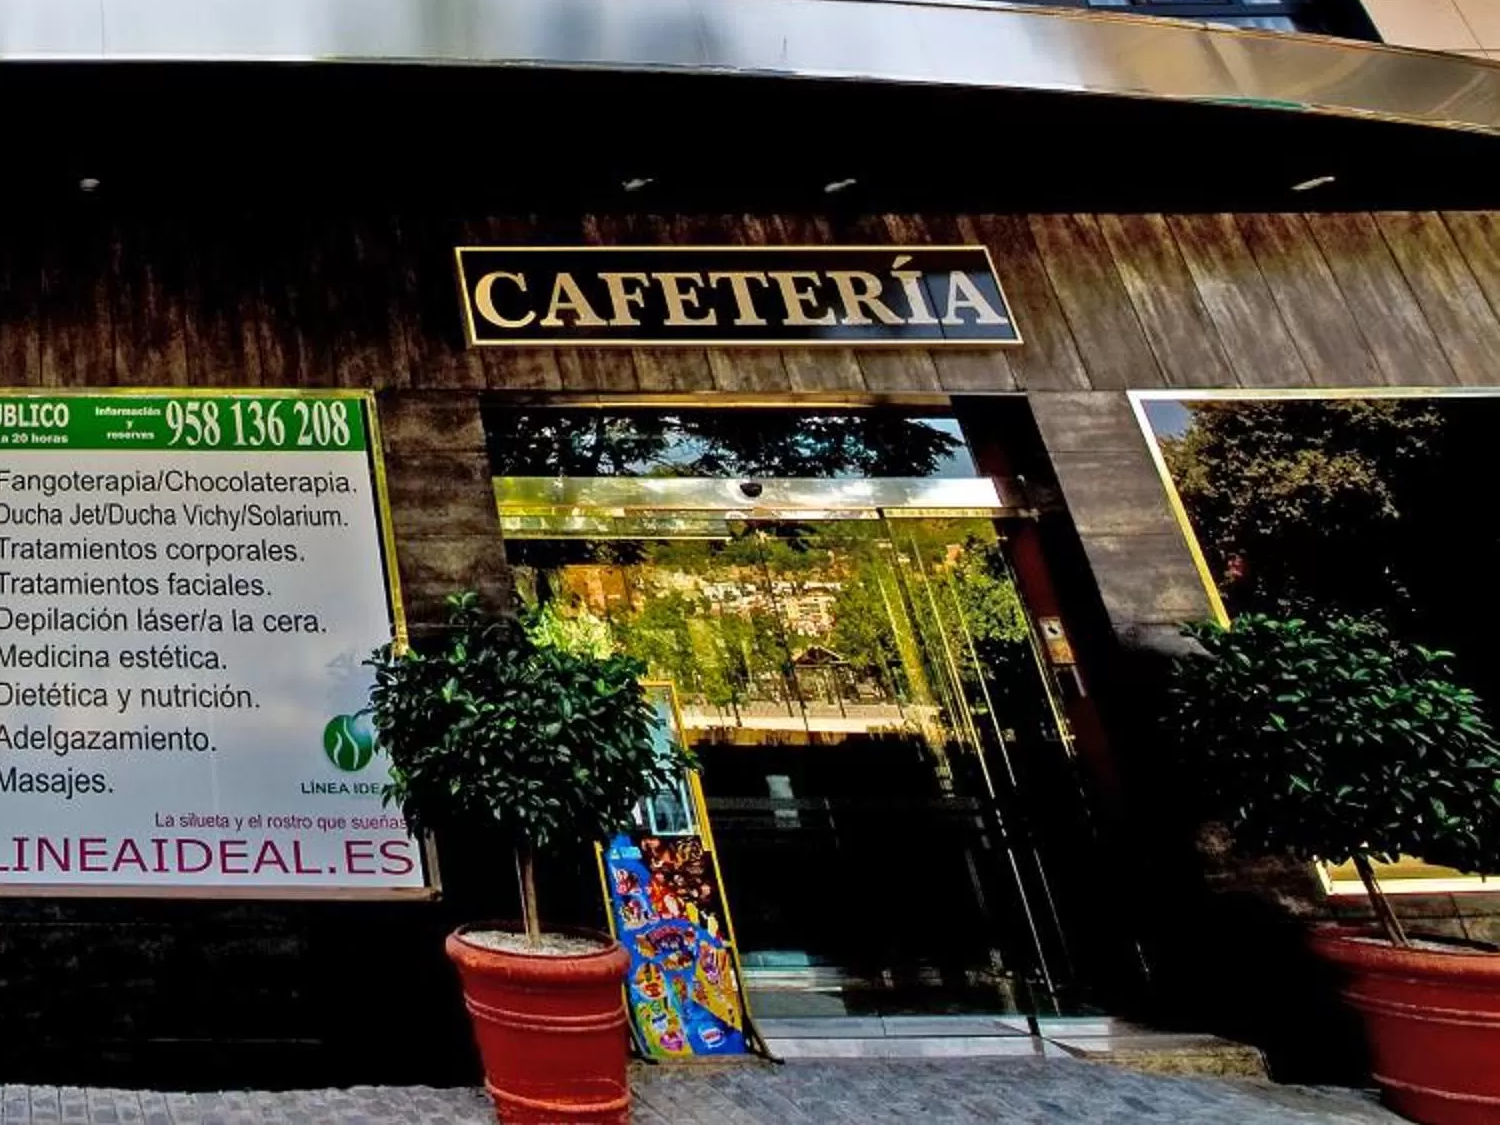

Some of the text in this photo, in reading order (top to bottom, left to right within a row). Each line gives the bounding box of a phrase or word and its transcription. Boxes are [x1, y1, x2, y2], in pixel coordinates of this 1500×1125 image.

[474, 255, 1008, 328] CAFETERÍA
[165, 399, 350, 446] 958 136 208
[11, 432, 28, 444] 20
[31, 431, 69, 444] horas
[69, 503, 177, 526] Jet/Ducha
[183, 504, 349, 531] Vichy/Solarium.
[165, 539, 306, 566] corporales.
[167, 573, 272, 596] faciales.
[137, 607, 224, 633] láser/a
[232, 609, 255, 632] la
[263, 613, 328, 633] cera.
[119, 645, 228, 670] estética.
[117, 689, 131, 713] y
[141, 683, 260, 709] nutrición.
[301, 782, 391, 795] LÍNEA IDE
[154, 812, 175, 828] La
[179, 812, 230, 828] silueta
[235, 816, 244, 832] y
[249, 814, 262, 828] el
[267, 815, 313, 829] rostro
[317, 817, 347, 832] que
